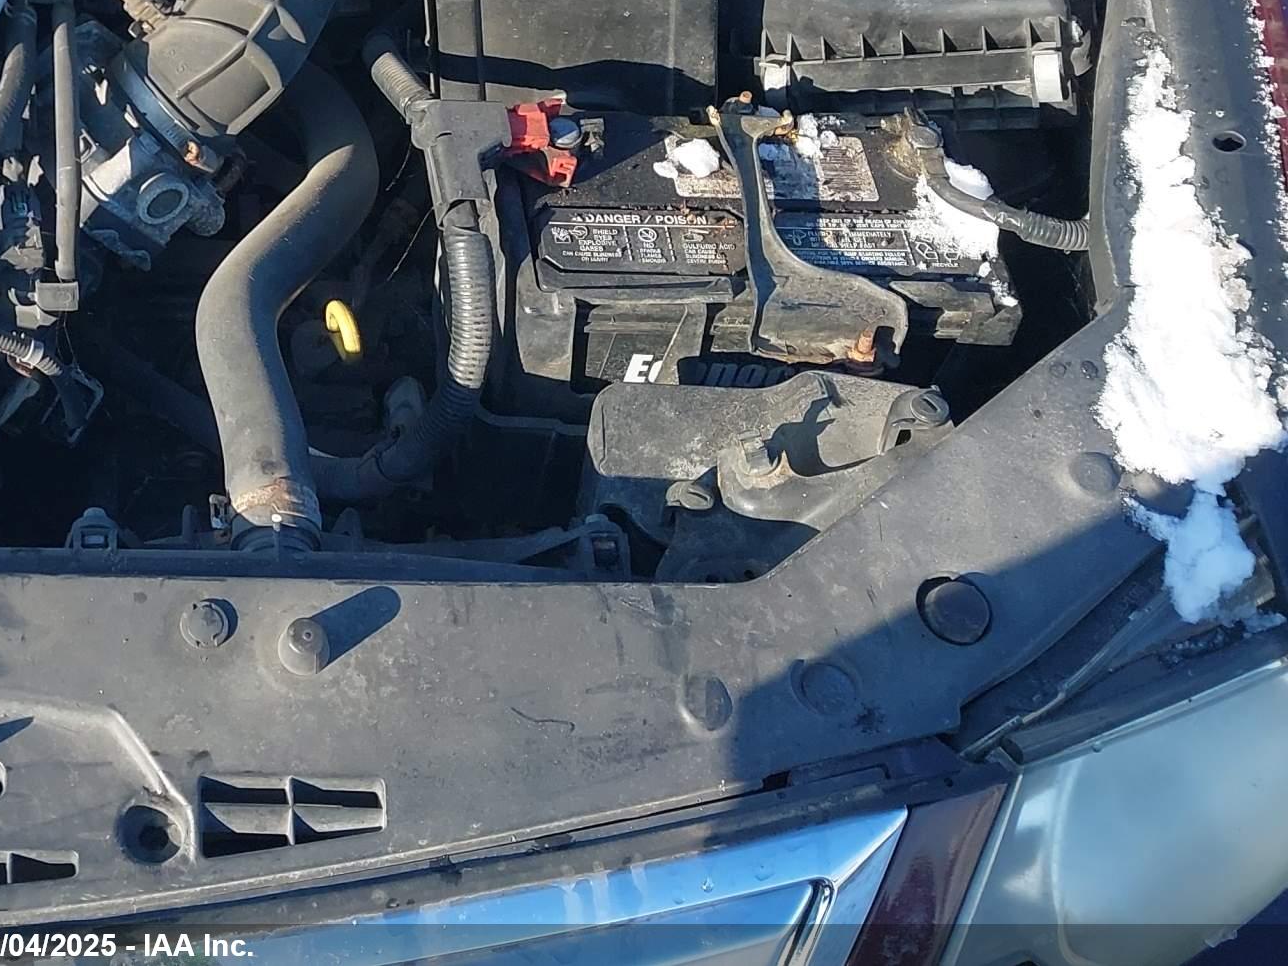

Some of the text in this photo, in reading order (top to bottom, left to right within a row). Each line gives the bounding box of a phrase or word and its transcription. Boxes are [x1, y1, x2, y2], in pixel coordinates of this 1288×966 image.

[585, 213, 707, 225] DANGER / POISON
